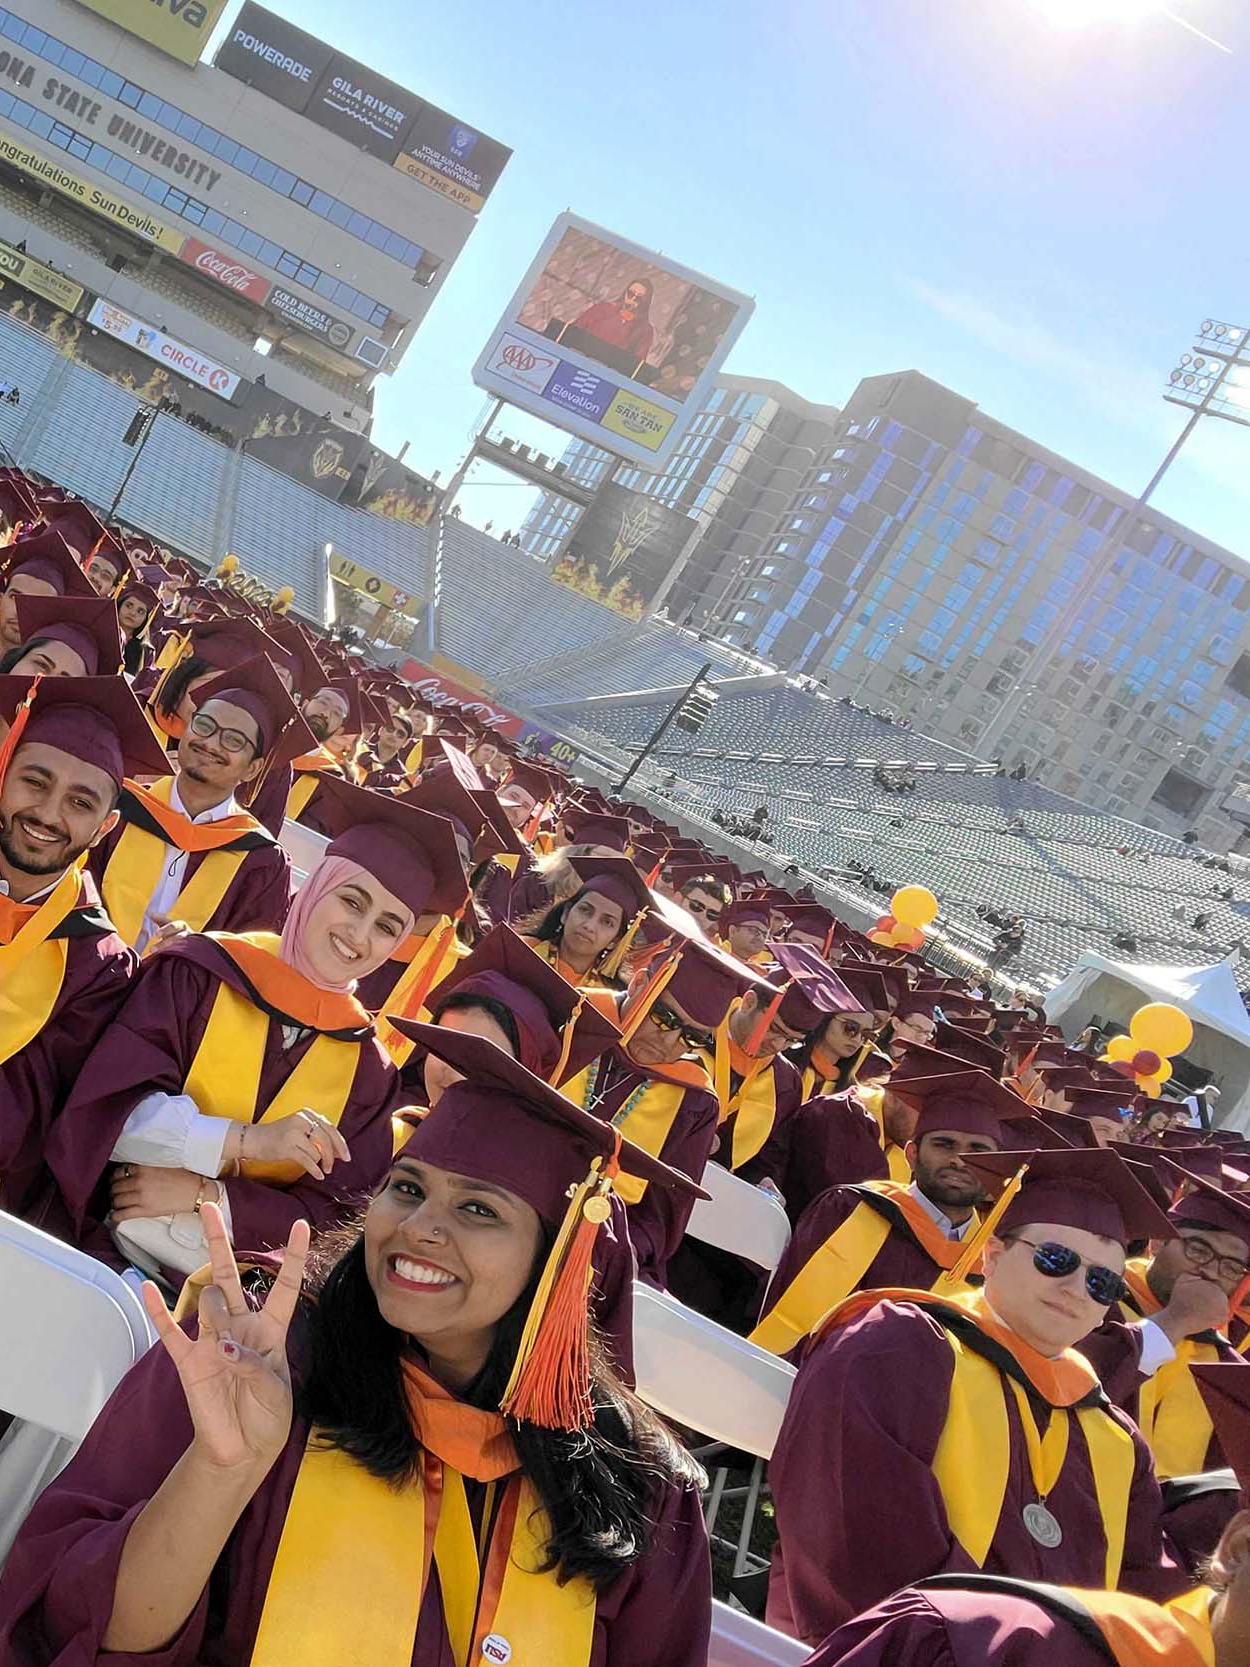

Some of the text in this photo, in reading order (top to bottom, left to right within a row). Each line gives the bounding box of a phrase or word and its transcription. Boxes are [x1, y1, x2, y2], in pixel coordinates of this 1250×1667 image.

[233, 29, 313, 82] POWERADE
[332, 77, 404, 123] GILA RIVER
[42, 78, 102, 125] STATE
[106, 114, 222, 192] UNIVERSITY
[421, 144, 441, 160] YOUR
[440, 155, 456, 168] SUN
[407, 164, 471, 203] GET THE APP
[271, 297, 330, 333] CHEESEBURGERS
[274, 290, 298, 307] COLD
[297, 303, 327, 324] BEERS
[161, 344, 209, 378] CIRCLE
[504, 347, 536, 371] AAA
[550, 383, 600, 414] Elevation
[550, 741, 576, 762] 40+
